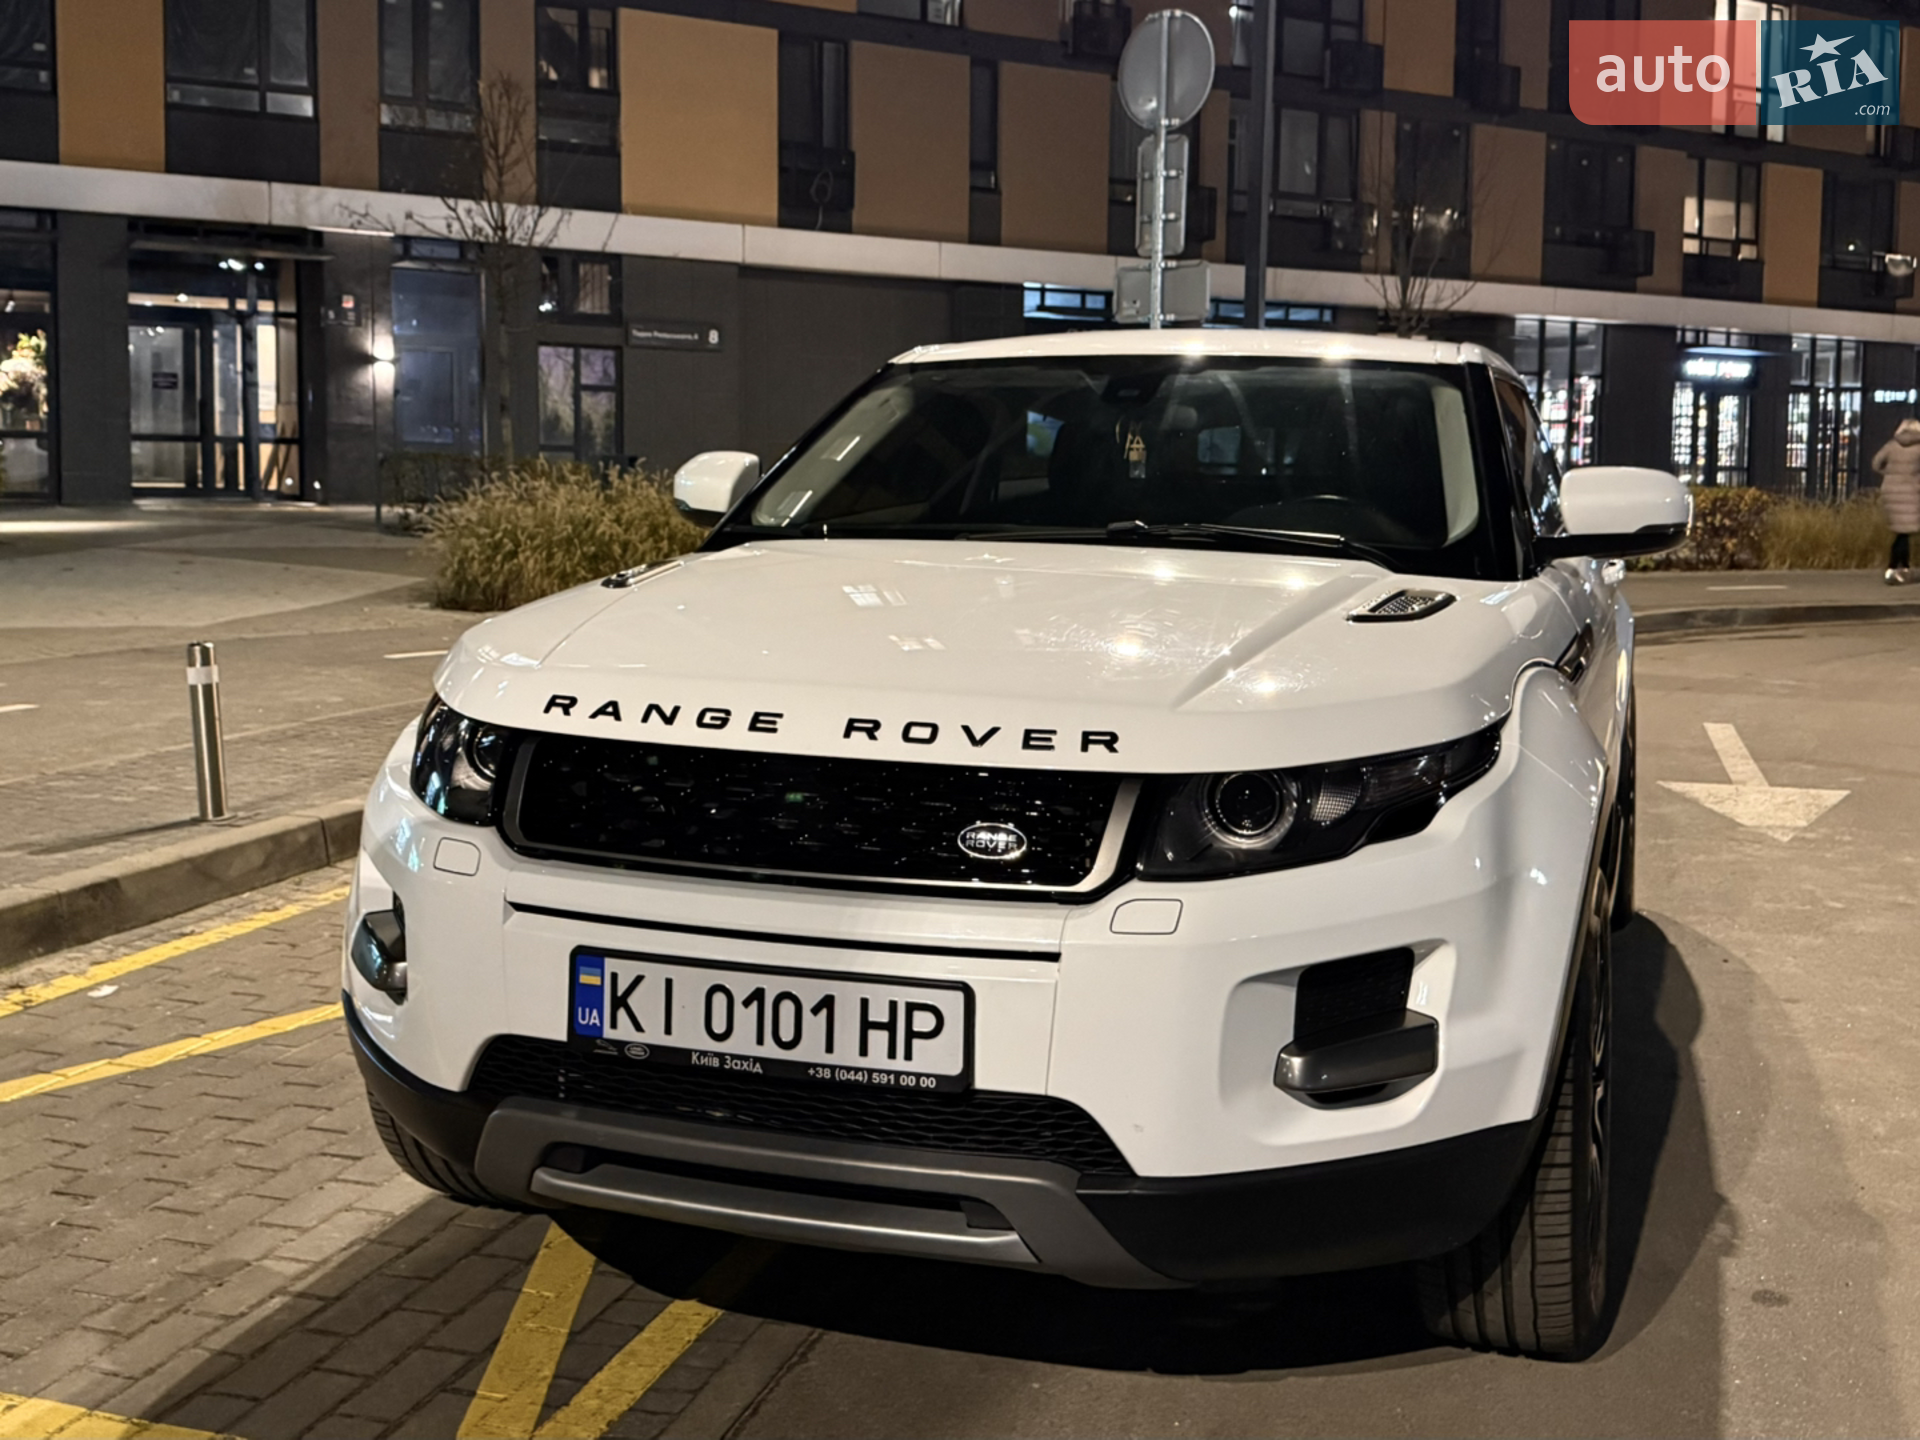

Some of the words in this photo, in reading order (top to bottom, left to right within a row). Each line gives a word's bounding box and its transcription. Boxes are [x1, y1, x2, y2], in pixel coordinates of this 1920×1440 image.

[708, 329, 719, 344] 8
[543, 694, 784, 734] RANGE
[843, 717, 1120, 754] ROVER
[966, 840, 1017, 850] ROVER
[578, 1006, 600, 1027] UA
[610, 971, 673, 1036] KI
[704, 983, 836, 1054] 0101
[859, 997, 945, 1062] HP
[691, 1051, 720, 1068] Київ
[724, 1055, 763, 1074] Захід
[808, 1068, 831, 1079] +38
[835, 1068, 868, 1083] (044)
[872, 1072, 895, 1085] 591
[900, 1075, 916, 1087] 00
[920, 1077, 936, 1088] 00
